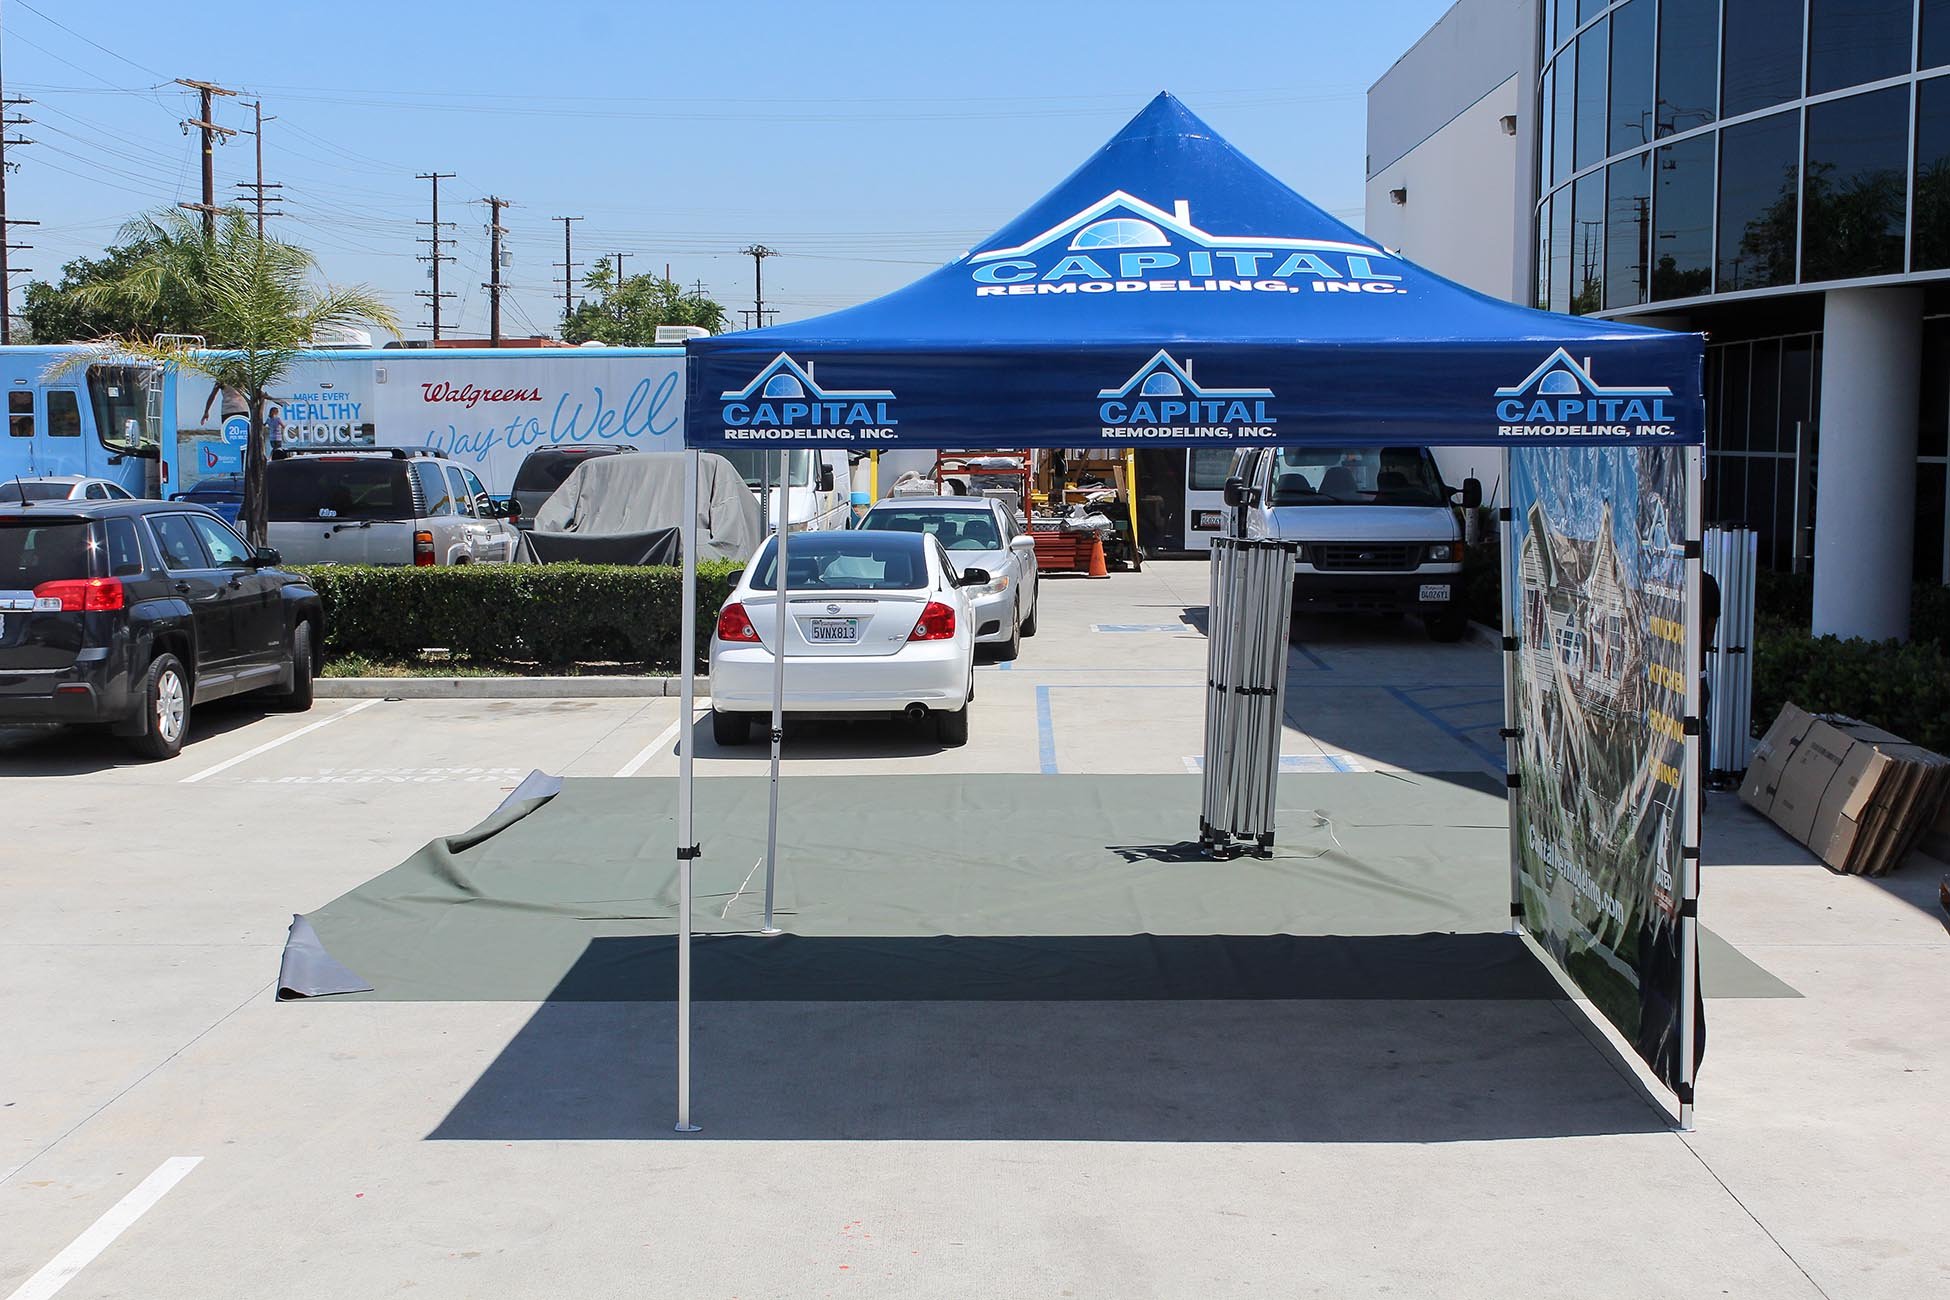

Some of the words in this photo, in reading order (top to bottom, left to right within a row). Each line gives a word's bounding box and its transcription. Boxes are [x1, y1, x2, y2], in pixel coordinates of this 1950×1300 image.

[971, 251, 1402, 284] CAPITAL
[976, 279, 1299, 297] REMODELING,
[1312, 280, 1408, 296] INC.
[293, 393, 319, 401] MAKE
[322, 392, 350, 401] EVERY
[421, 381, 543, 409] Walgreens
[283, 403, 362, 420] HEALTHY
[425, 425, 503, 462] Way
[504, 416, 547, 449] to
[550, 371, 679, 444] Well
[722, 402, 898, 426] CAPITAL
[1100, 401, 1277, 425] CAPITAL
[1496, 399, 1675, 423] CAPITAL
[229, 426, 240, 436] 20
[284, 423, 363, 443] CHOICE
[724, 428, 855, 441] REMODELING,
[860, 428, 898, 440] INC.
[1101, 426, 1233, 439] REMODELING,
[1238, 426, 1277, 438] INC.
[1498, 425, 1631, 437] REMODELING,
[1635, 425, 1675, 436] INC.
[813, 627, 856, 639] 5VNX813
